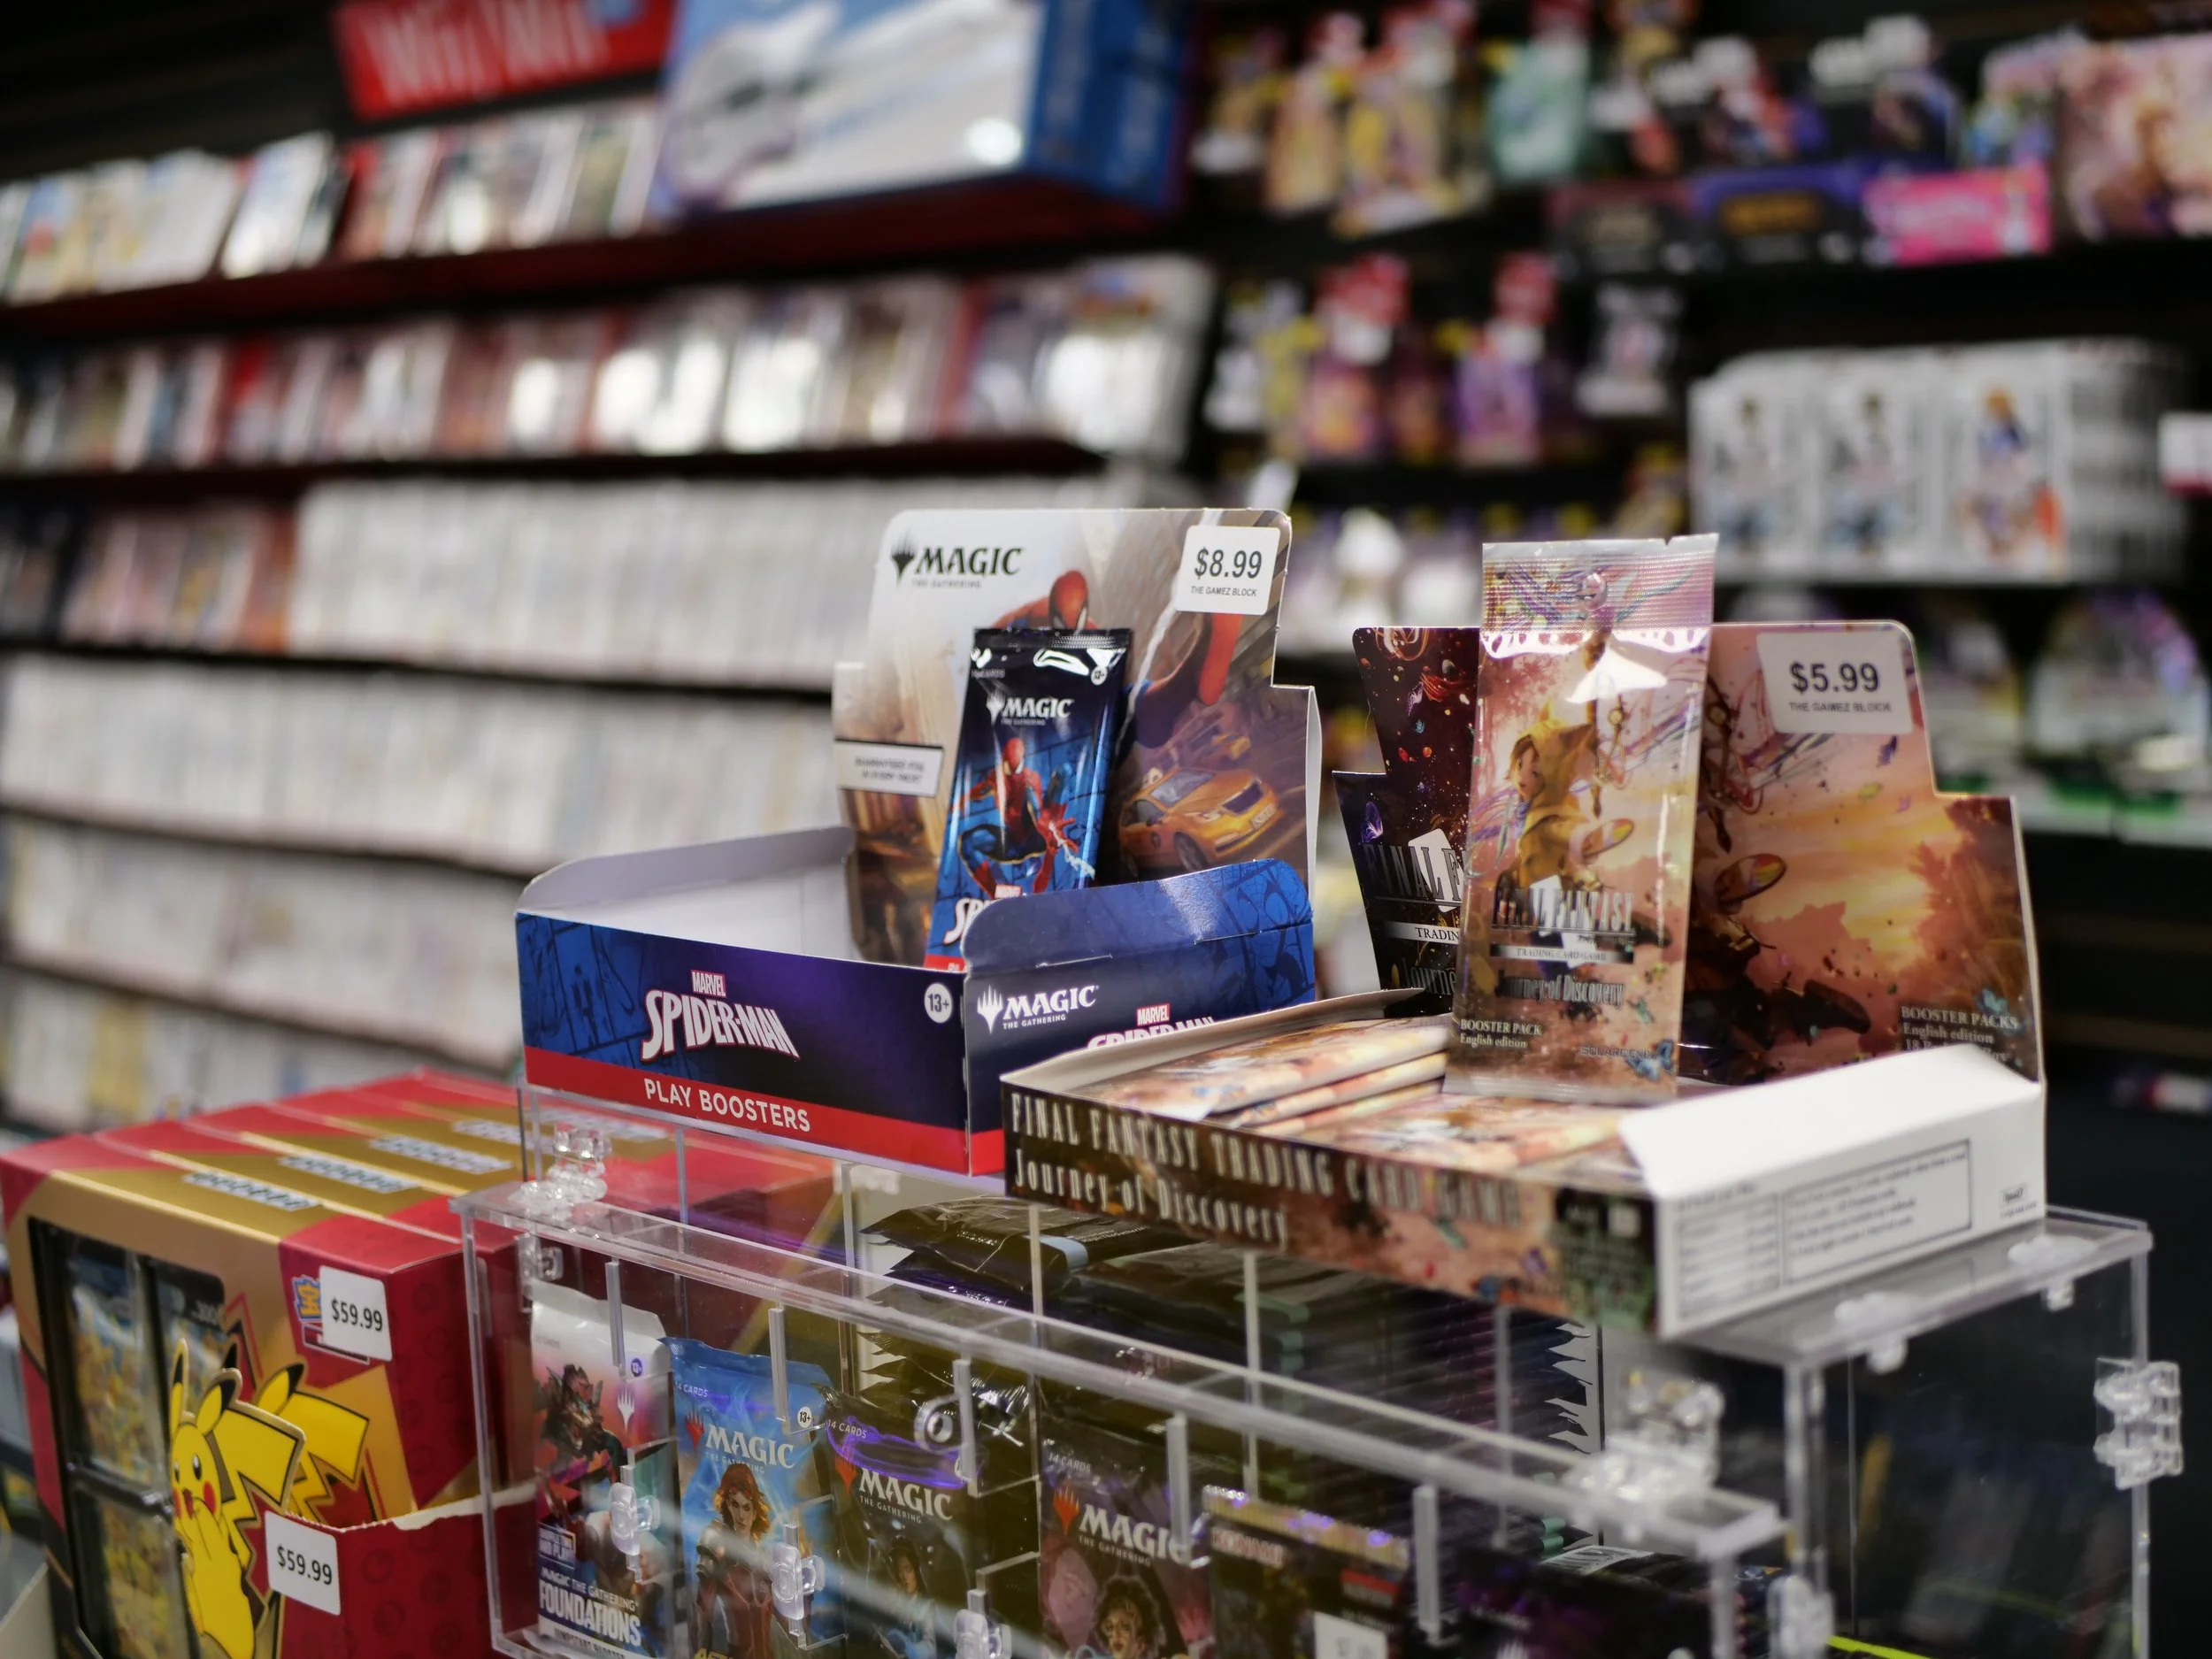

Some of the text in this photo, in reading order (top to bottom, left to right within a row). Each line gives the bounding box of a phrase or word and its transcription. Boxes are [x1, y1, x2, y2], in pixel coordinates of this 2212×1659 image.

[915, 546, 1024, 577] MAGIC
[1194, 547, 1262, 580] $8.99
[1191, 586, 1257, 597] THE GAMEZ BLOCK
[1789, 662, 1879, 695] $5.99
[1001, 697, 1074, 718] MAGIC
[1788, 702, 1809, 712] THE
[1415, 926, 1460, 942] TRADIN
[691, 971, 726, 998] MARVEL
[1563, 975, 1625, 1010] Discovery
[928, 994, 950, 1013] 13+
[1002, 985, 1096, 1021] MAGIC
[1138, 1004, 1170, 1025] MARVEL
[1901, 1006, 2018, 1029] BOOSTER PACKS
[641, 989, 800, 1060] SPIDER-MAN
[1021, 1014, 1066, 1027] GATHERING
[1461, 1018, 1542, 1036] BOOSTER PACK
[1903, 1023, 1994, 1043] English edition
[1460, 1033, 1528, 1048] English edition
[643, 1078, 811, 1133] PLAY BOOSTERS
[1011, 1092, 1079, 1145] FINAL
[1089, 1108, 1199, 1171] FANTASY
[1210, 1133, 1334, 1197] TRADING
[1015, 1148, 1288, 1253] Journey of Discovery
[331, 1298, 383, 1332] $59.99
[683, 1384, 709, 1398] CARDS
[799, 1410, 811, 1424] 13+
[827, 1418, 867, 1439] 14 CARDS
[705, 1424, 796, 1469] MAGIC
[1060, 1456, 1092, 1474] CARDS
[858, 1468, 953, 1521] MAGIC
[860, 1494, 922, 1524] THE GATHERING
[277, 1544, 333, 1586] $59.99
[1079, 1535, 1150, 1567] THE GATHERING
[572, 1578, 587, 1594] THE
[588, 1585, 636, 1612] GATHERING
[539, 1578, 641, 1647] FOUNDATIONS
